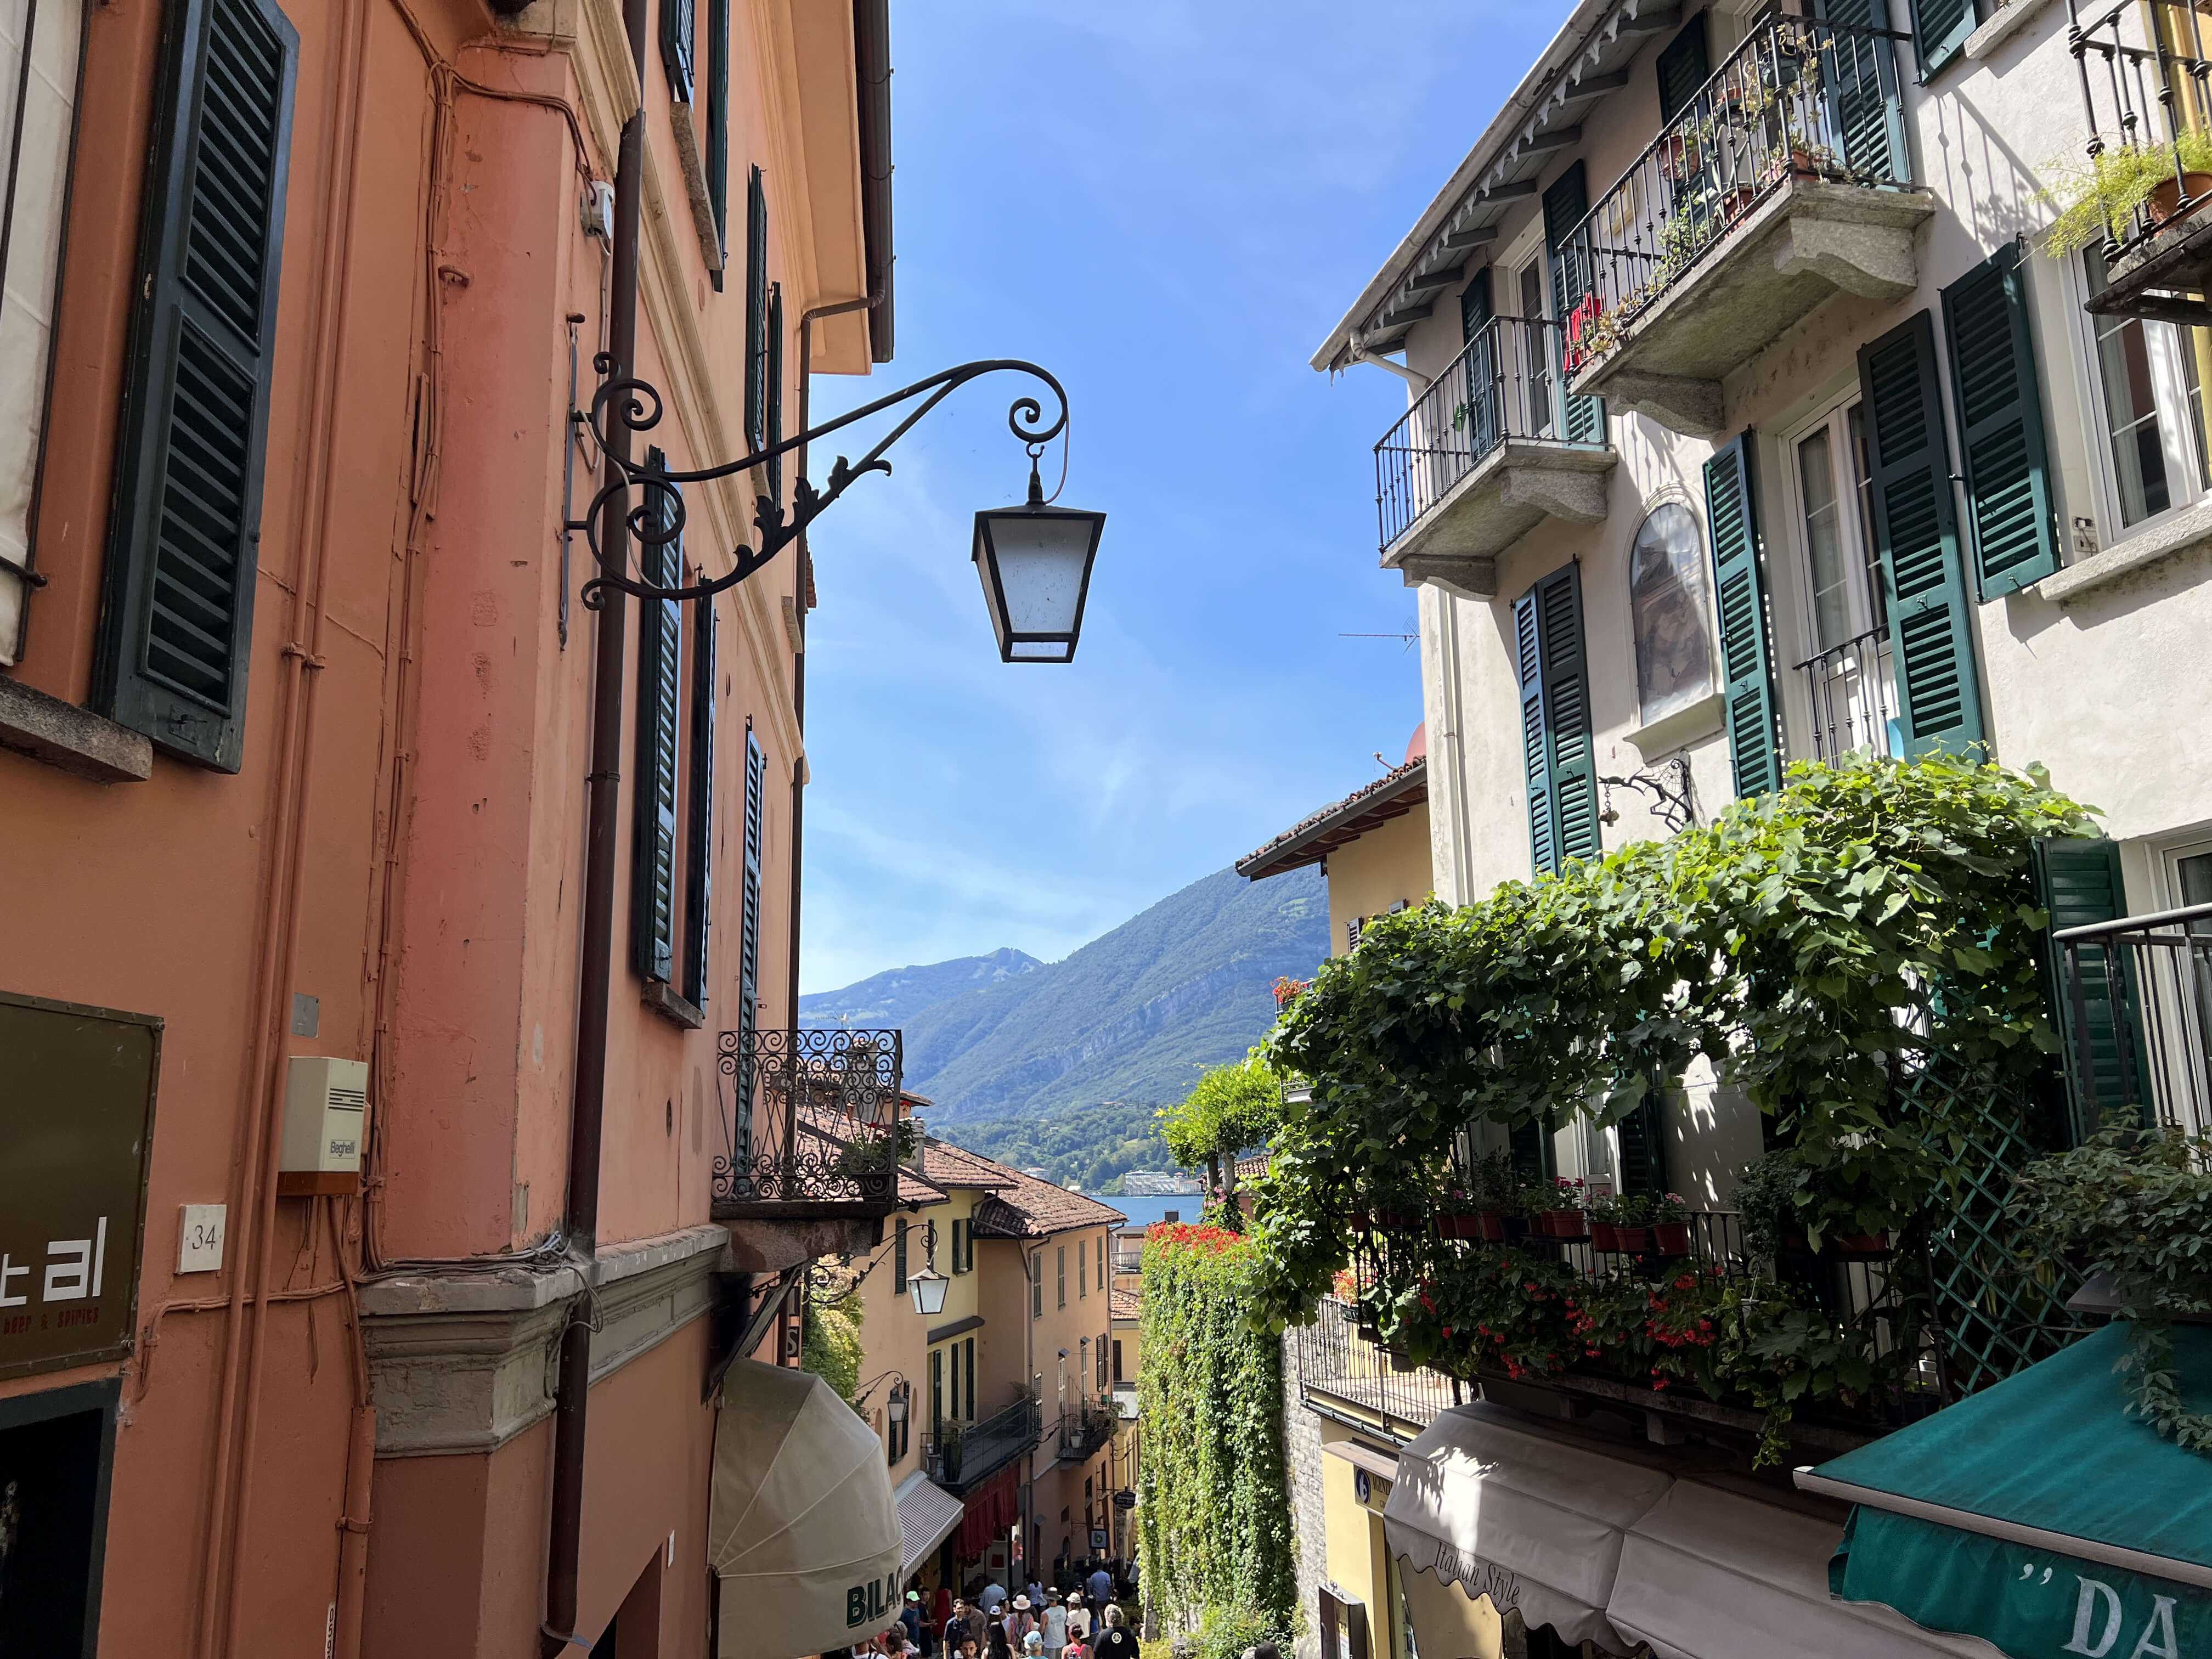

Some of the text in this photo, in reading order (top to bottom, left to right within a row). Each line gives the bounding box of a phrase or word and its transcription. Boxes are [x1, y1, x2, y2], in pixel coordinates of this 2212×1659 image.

[330, 1141, 356, 1158] Beghelli
[192, 1224, 216, 1250] 34
[1434, 1541, 1520, 1607] Italian Style
